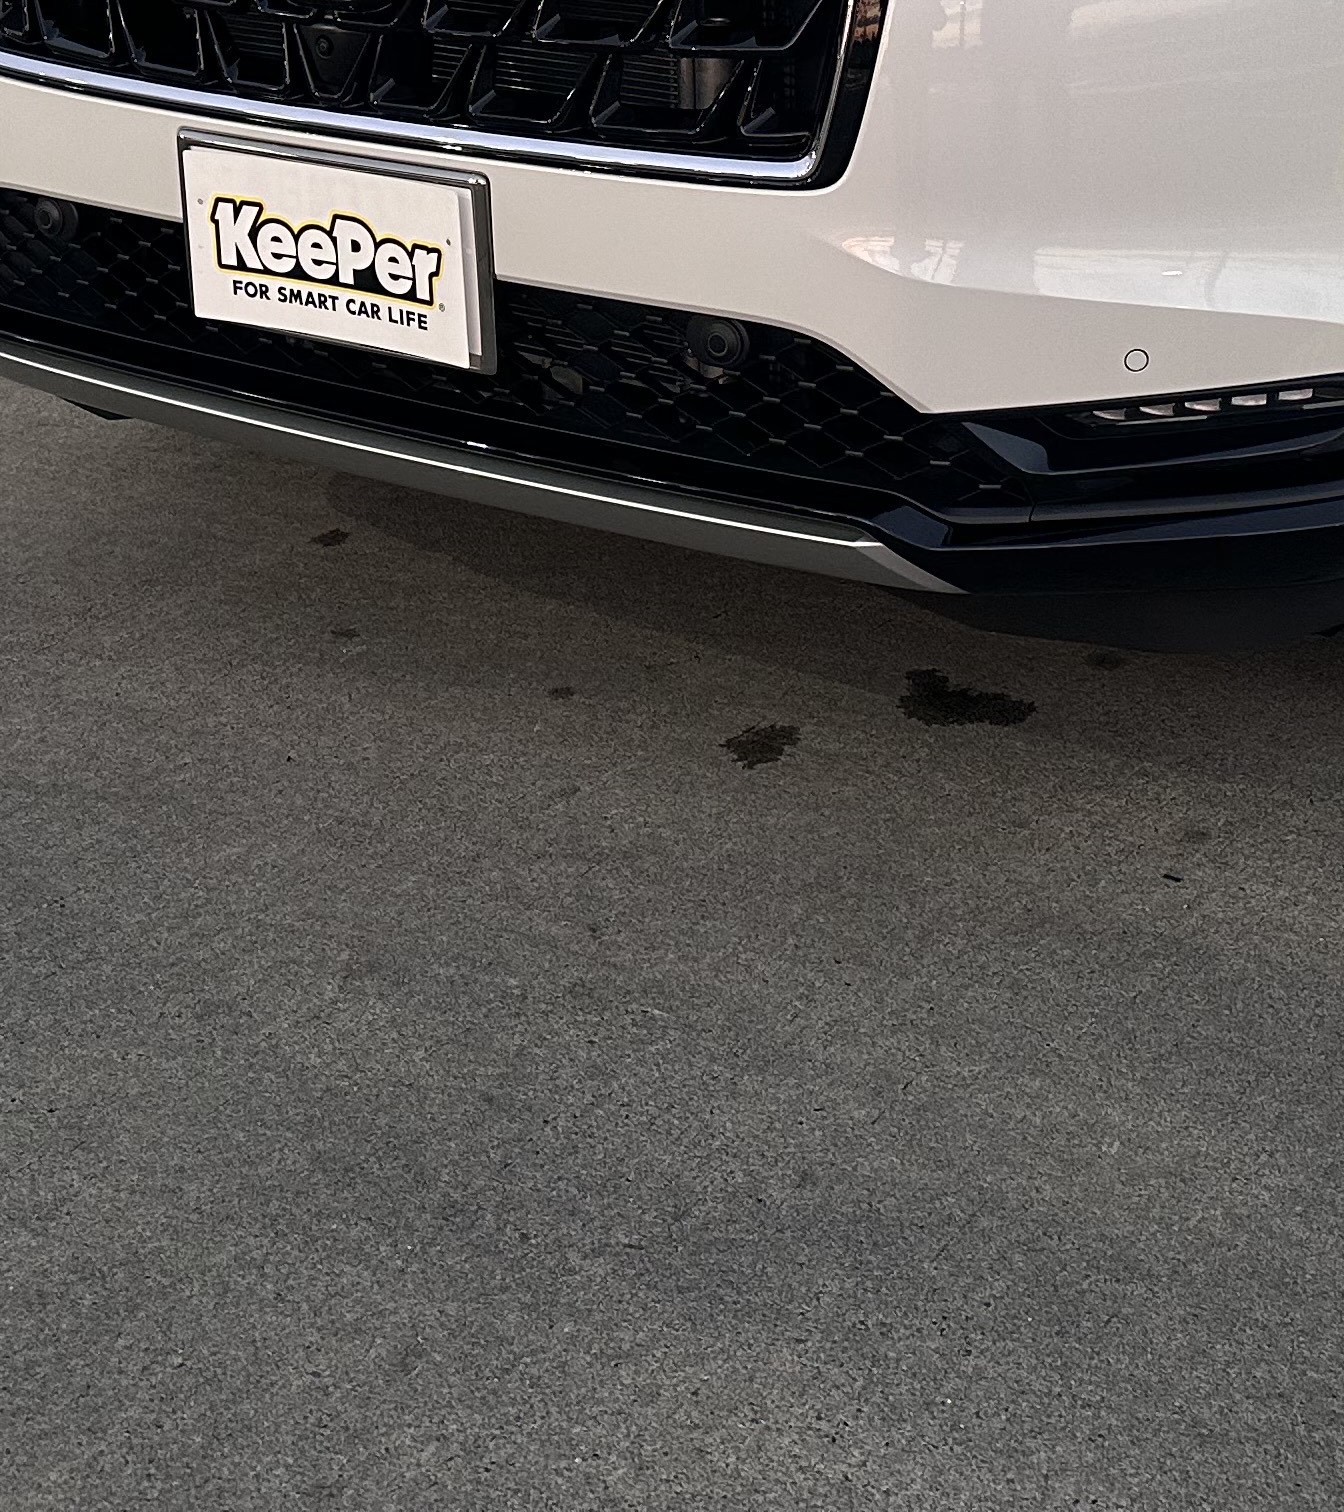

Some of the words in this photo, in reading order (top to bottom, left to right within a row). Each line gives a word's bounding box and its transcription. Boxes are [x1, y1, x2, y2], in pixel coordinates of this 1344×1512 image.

[211, 197, 442, 306] KeePer
[232, 279, 271, 300] FOR
[277, 286, 339, 312] SMART
[345, 299, 382, 320] CAR
[388, 306, 429, 331] LIFE
